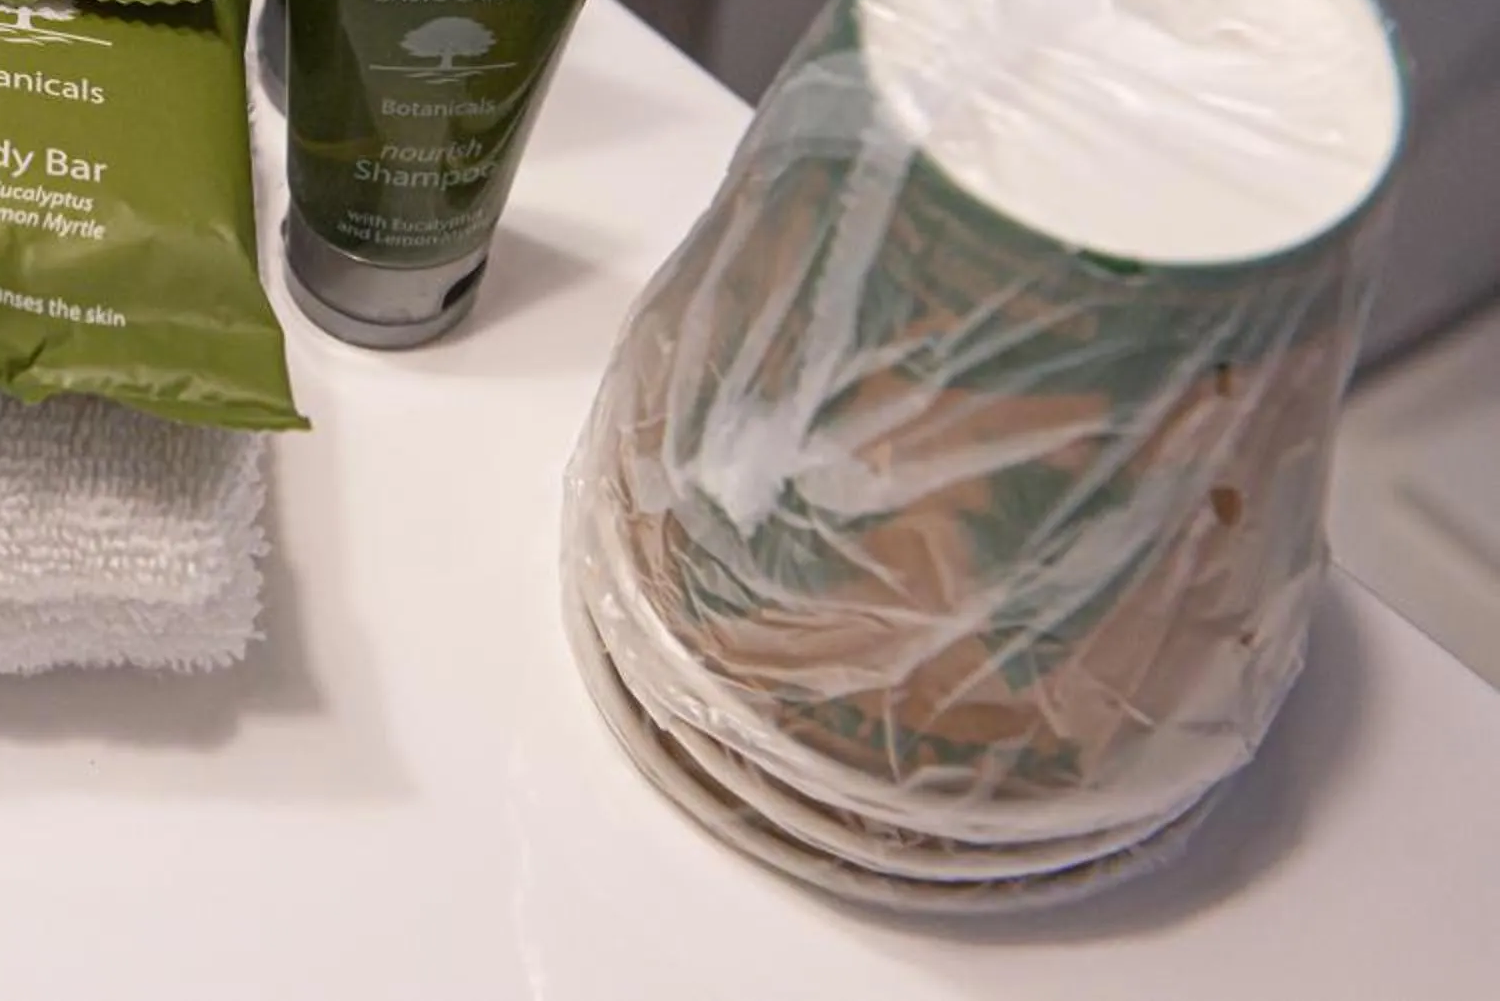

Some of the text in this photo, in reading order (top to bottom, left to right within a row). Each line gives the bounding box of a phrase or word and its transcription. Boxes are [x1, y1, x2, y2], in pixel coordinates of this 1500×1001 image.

[381, 98, 496, 117] Botanicals
[45, 147, 107, 182] Bar
[380, 137, 483, 163] nourish
[42, 211, 106, 240] Myrtle
[47, 296, 82, 322] the
[85, 304, 127, 328] skin
